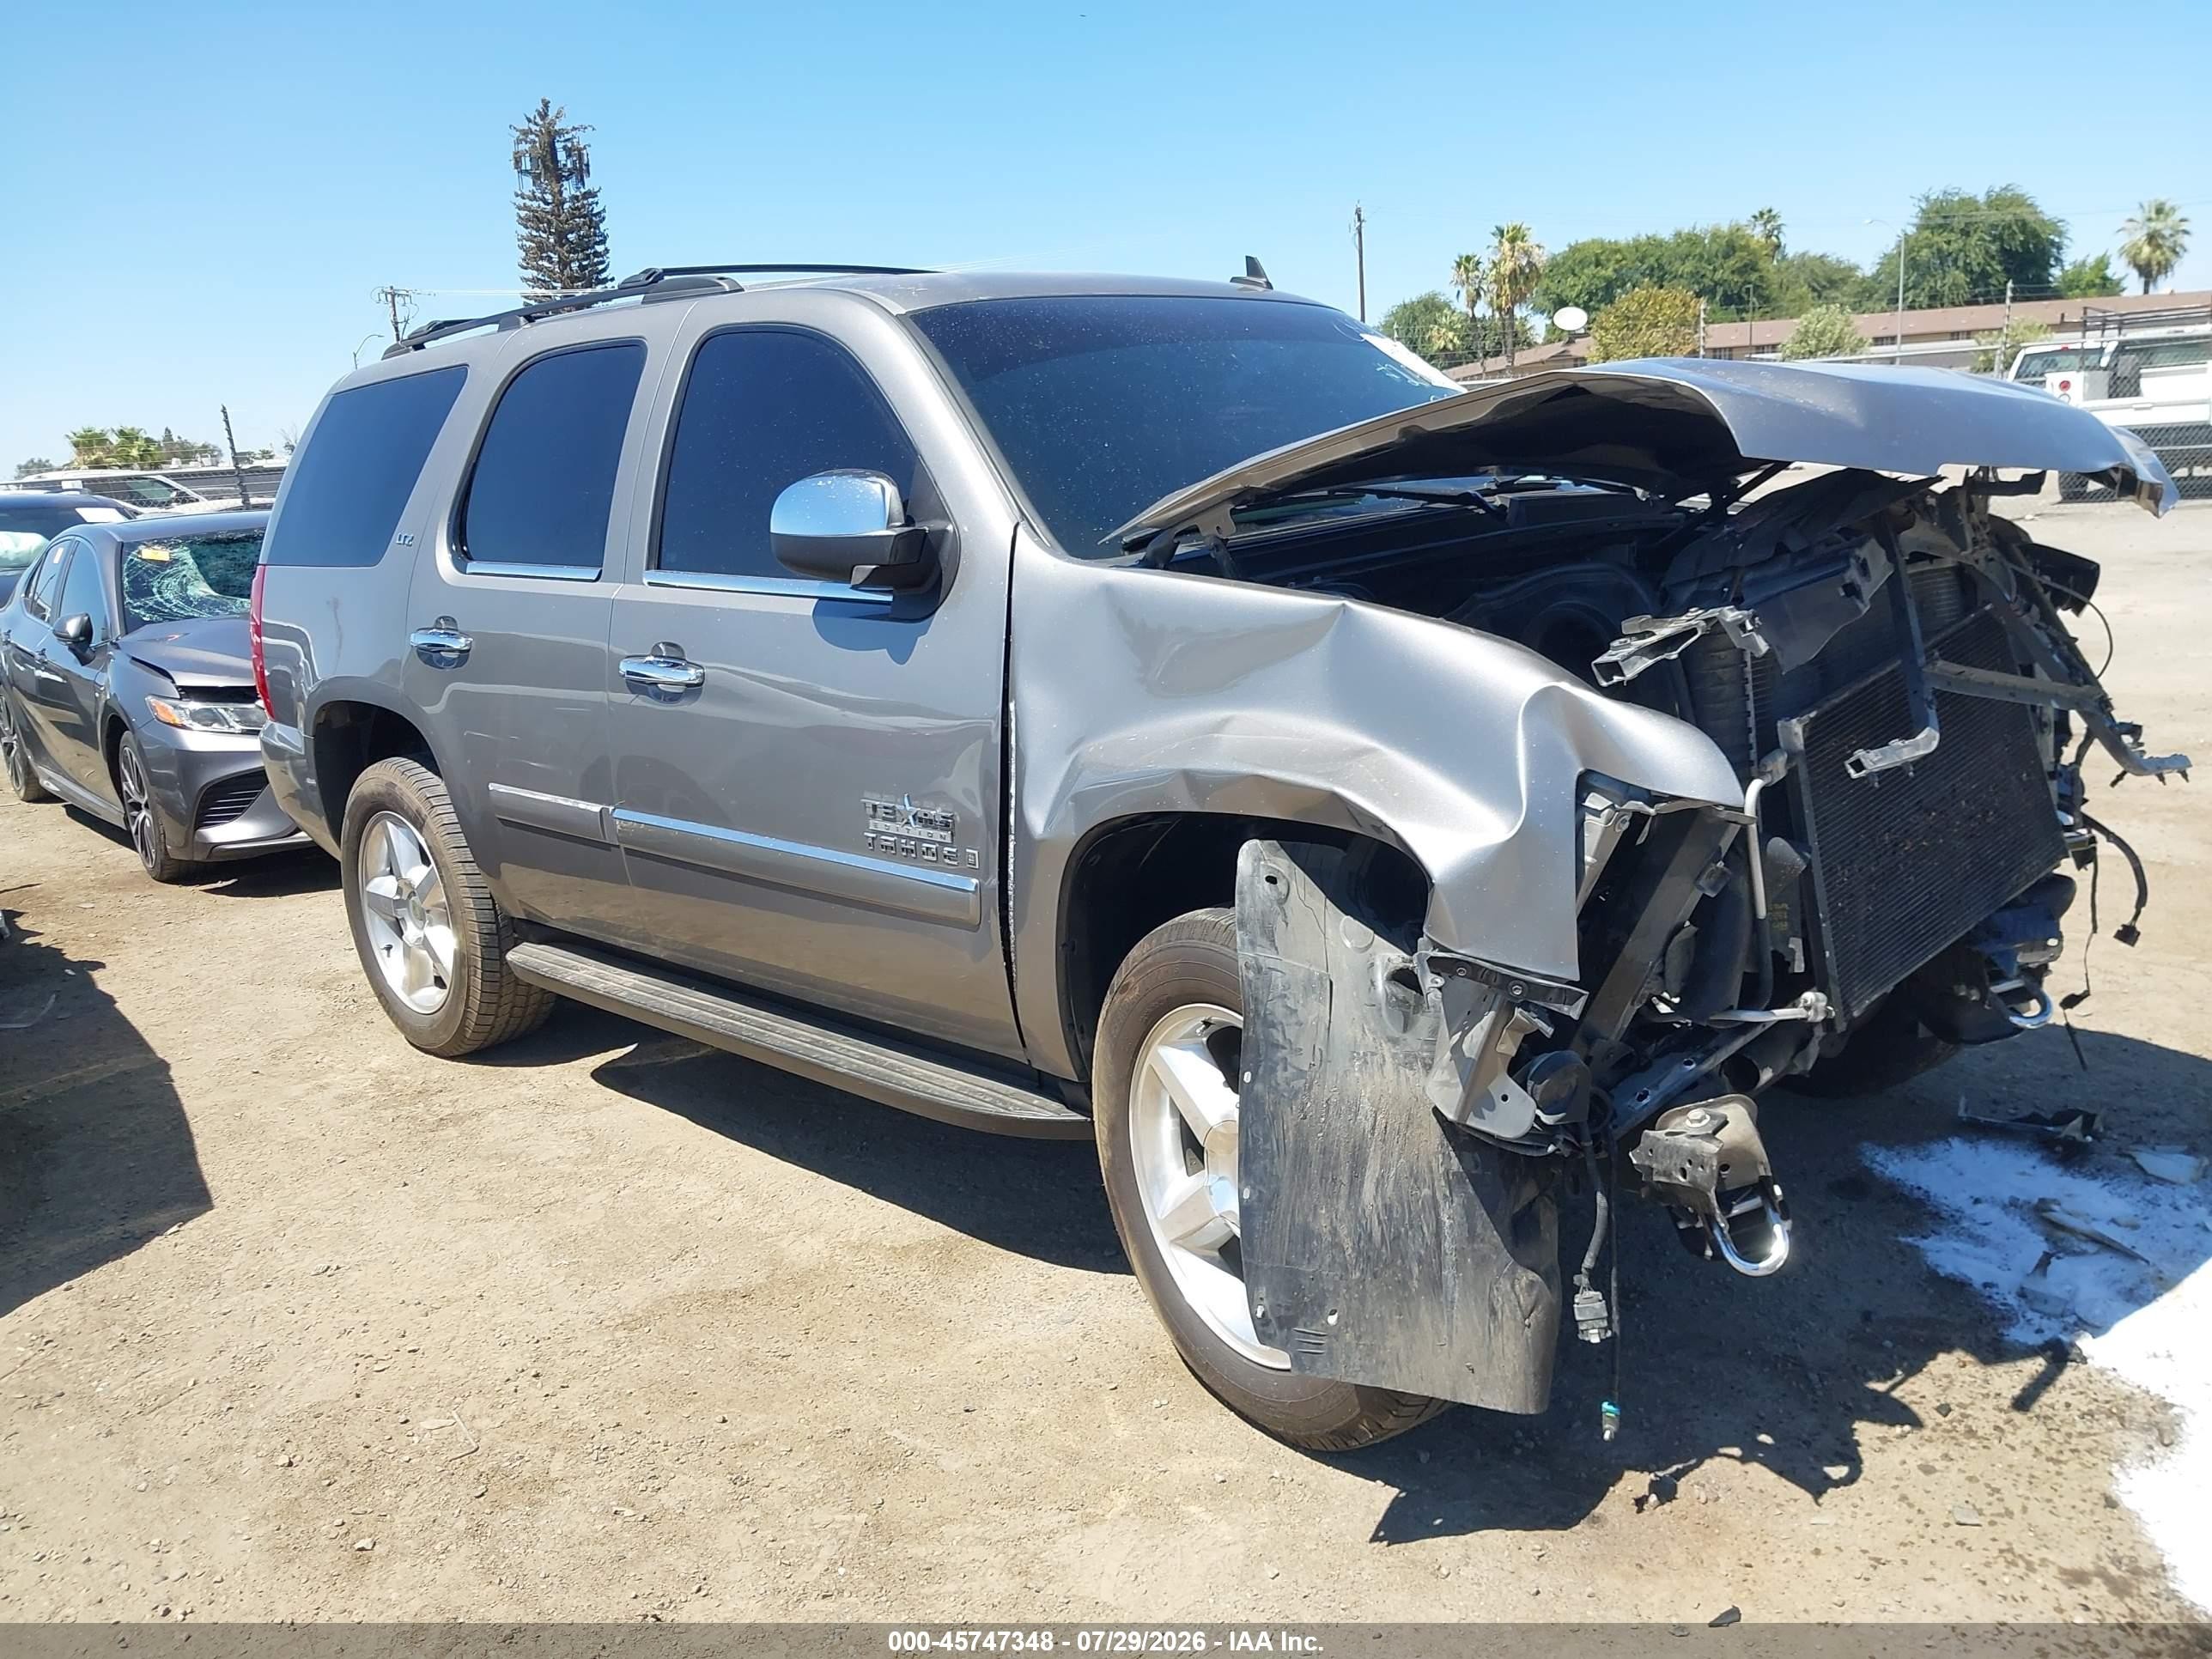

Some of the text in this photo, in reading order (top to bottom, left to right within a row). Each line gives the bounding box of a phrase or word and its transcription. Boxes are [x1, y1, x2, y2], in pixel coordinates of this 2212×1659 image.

[860, 794, 955, 830] TEXAS
[872, 821, 948, 842] EDITION
[864, 832, 958, 866] TAHOE
